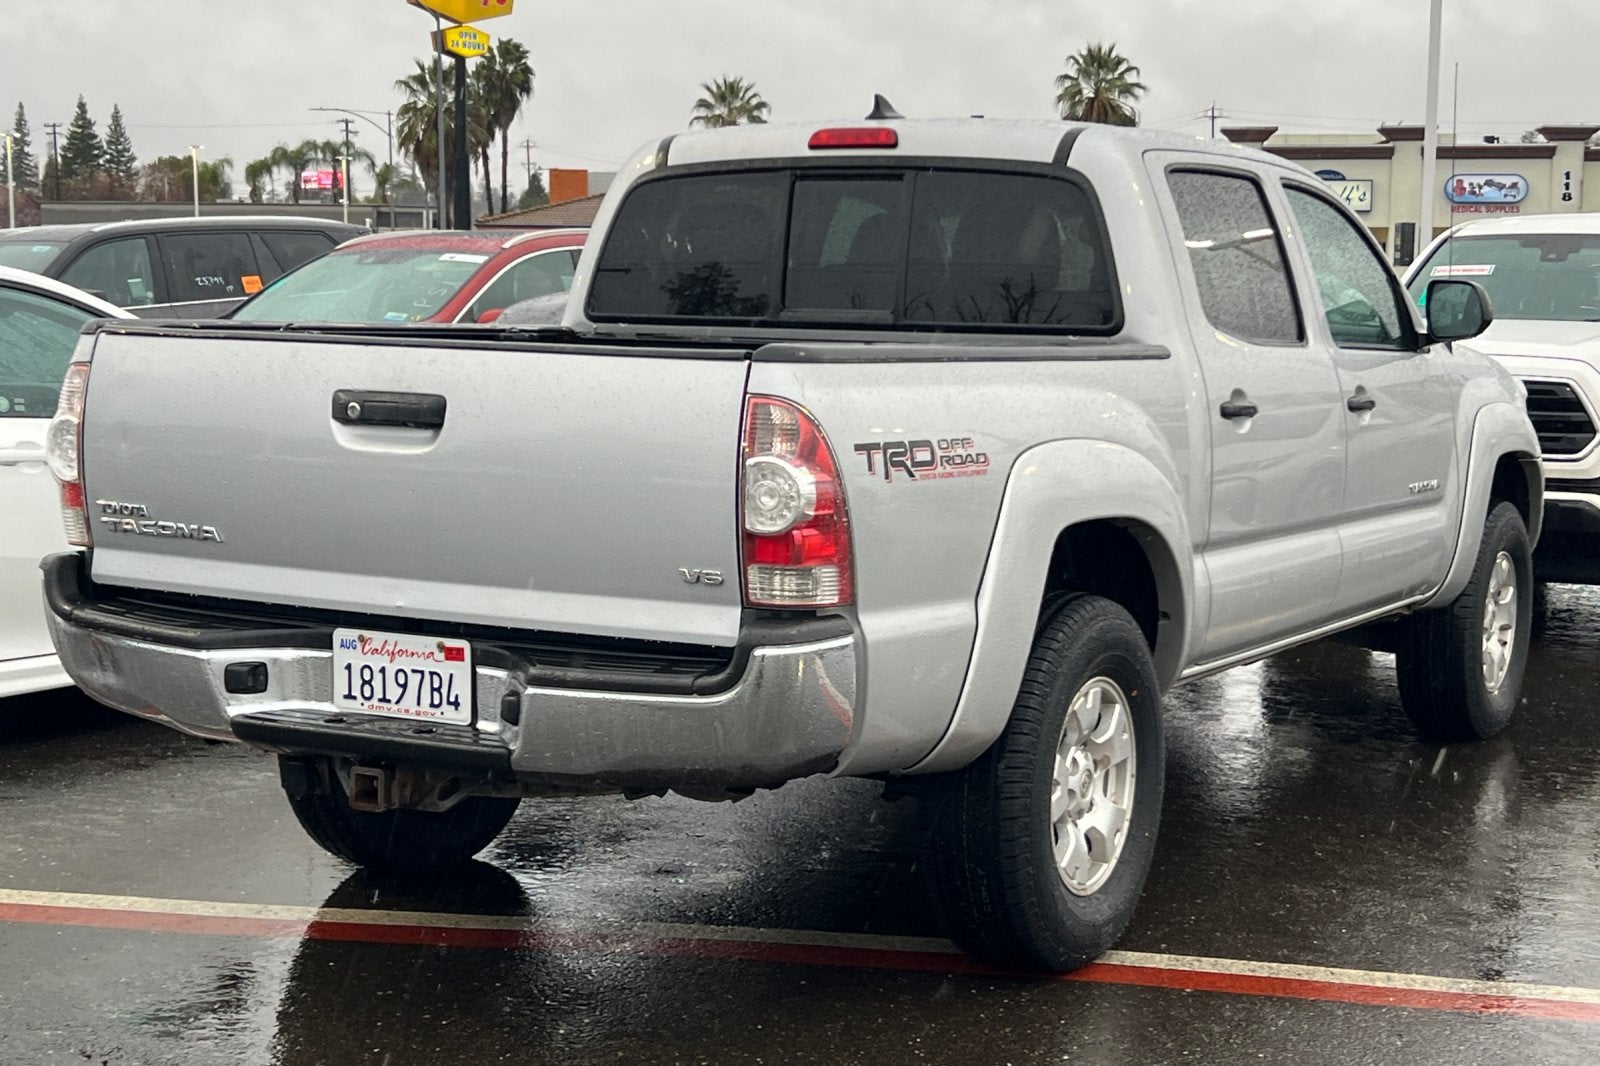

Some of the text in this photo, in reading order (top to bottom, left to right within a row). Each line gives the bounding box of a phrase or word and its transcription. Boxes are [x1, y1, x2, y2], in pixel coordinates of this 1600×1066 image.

[459, 31, 477, 40] OPEN
[451, 40, 485, 51] 24 HOURS
[1450, 204, 1521, 214] MEDICAL SUPPLIES
[937, 437, 975, 454] OFF
[853, 439, 938, 483] TRD
[939, 452, 991, 470] ROAD
[96, 499, 151, 518] TOYOTA
[100, 516, 224, 543] TACOMA
[678, 568, 725, 586] V6
[339, 638, 358, 651] AUG
[361, 637, 445, 664] California
[343, 662, 461, 711] 18197B4
[367, 703, 437, 717] dmv.ca.gov
